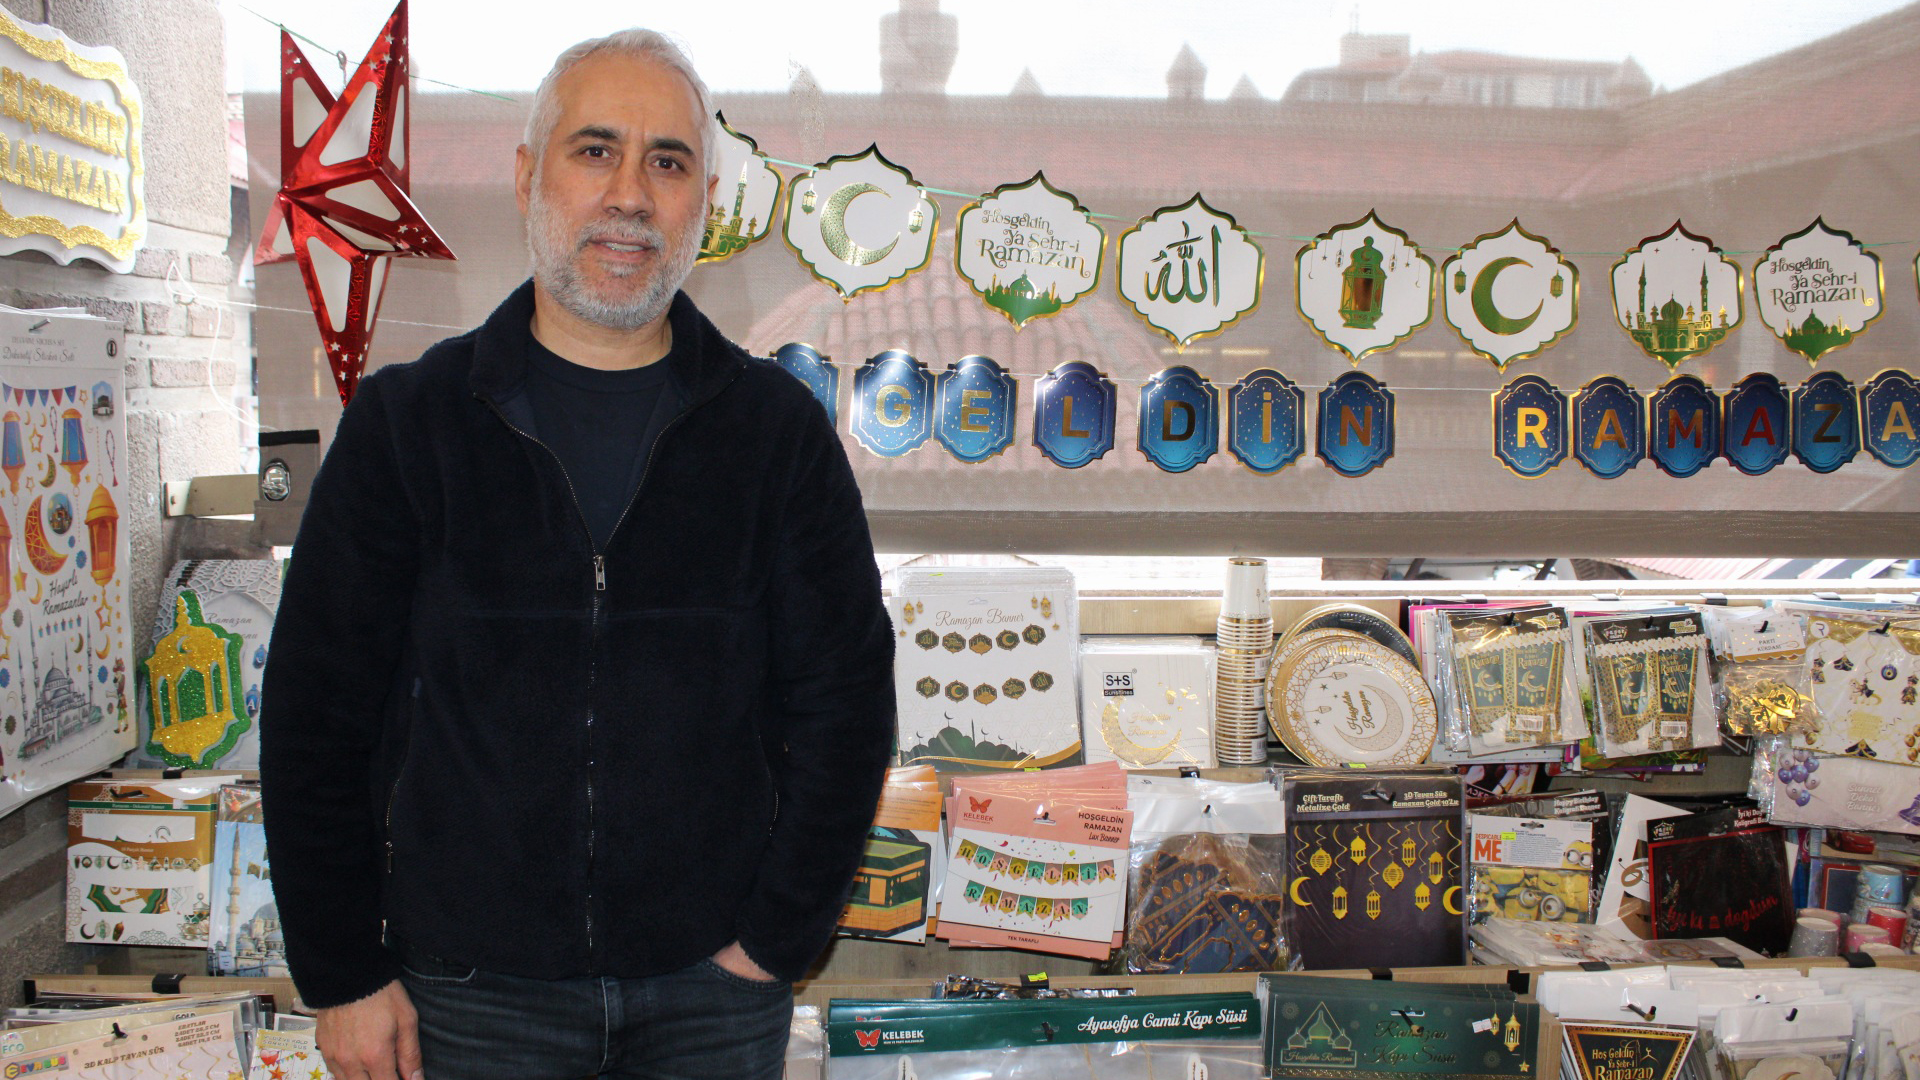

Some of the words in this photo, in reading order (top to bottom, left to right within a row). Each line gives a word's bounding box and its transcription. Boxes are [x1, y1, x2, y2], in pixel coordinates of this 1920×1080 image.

[976, 238, 1091, 279] Ramazan
[1769, 287, 1875, 313] Ramazan
[936, 610, 983, 631] Ramazan
[987, 608, 1025, 624] Banner
[1105, 674, 1131, 686] S+S
[1425, 799, 1441, 807] Gold
[963, 812, 994, 822] KELEBEK
[1078, 812, 1124, 824] HOŞGELDİN
[1083, 823, 1122, 834] RAMAZAN
[1474, 840, 1502, 863] ME
[1077, 1014, 1140, 1035] Ayasofya
[1181, 1010, 1214, 1030] Kapı
[1214, 1008, 1248, 1025] Süsü
[881, 1029, 925, 1040] KELEBEK
[1375, 1020, 1449, 1044] Razan
[1594, 1065, 1654, 1080] Ramazan
